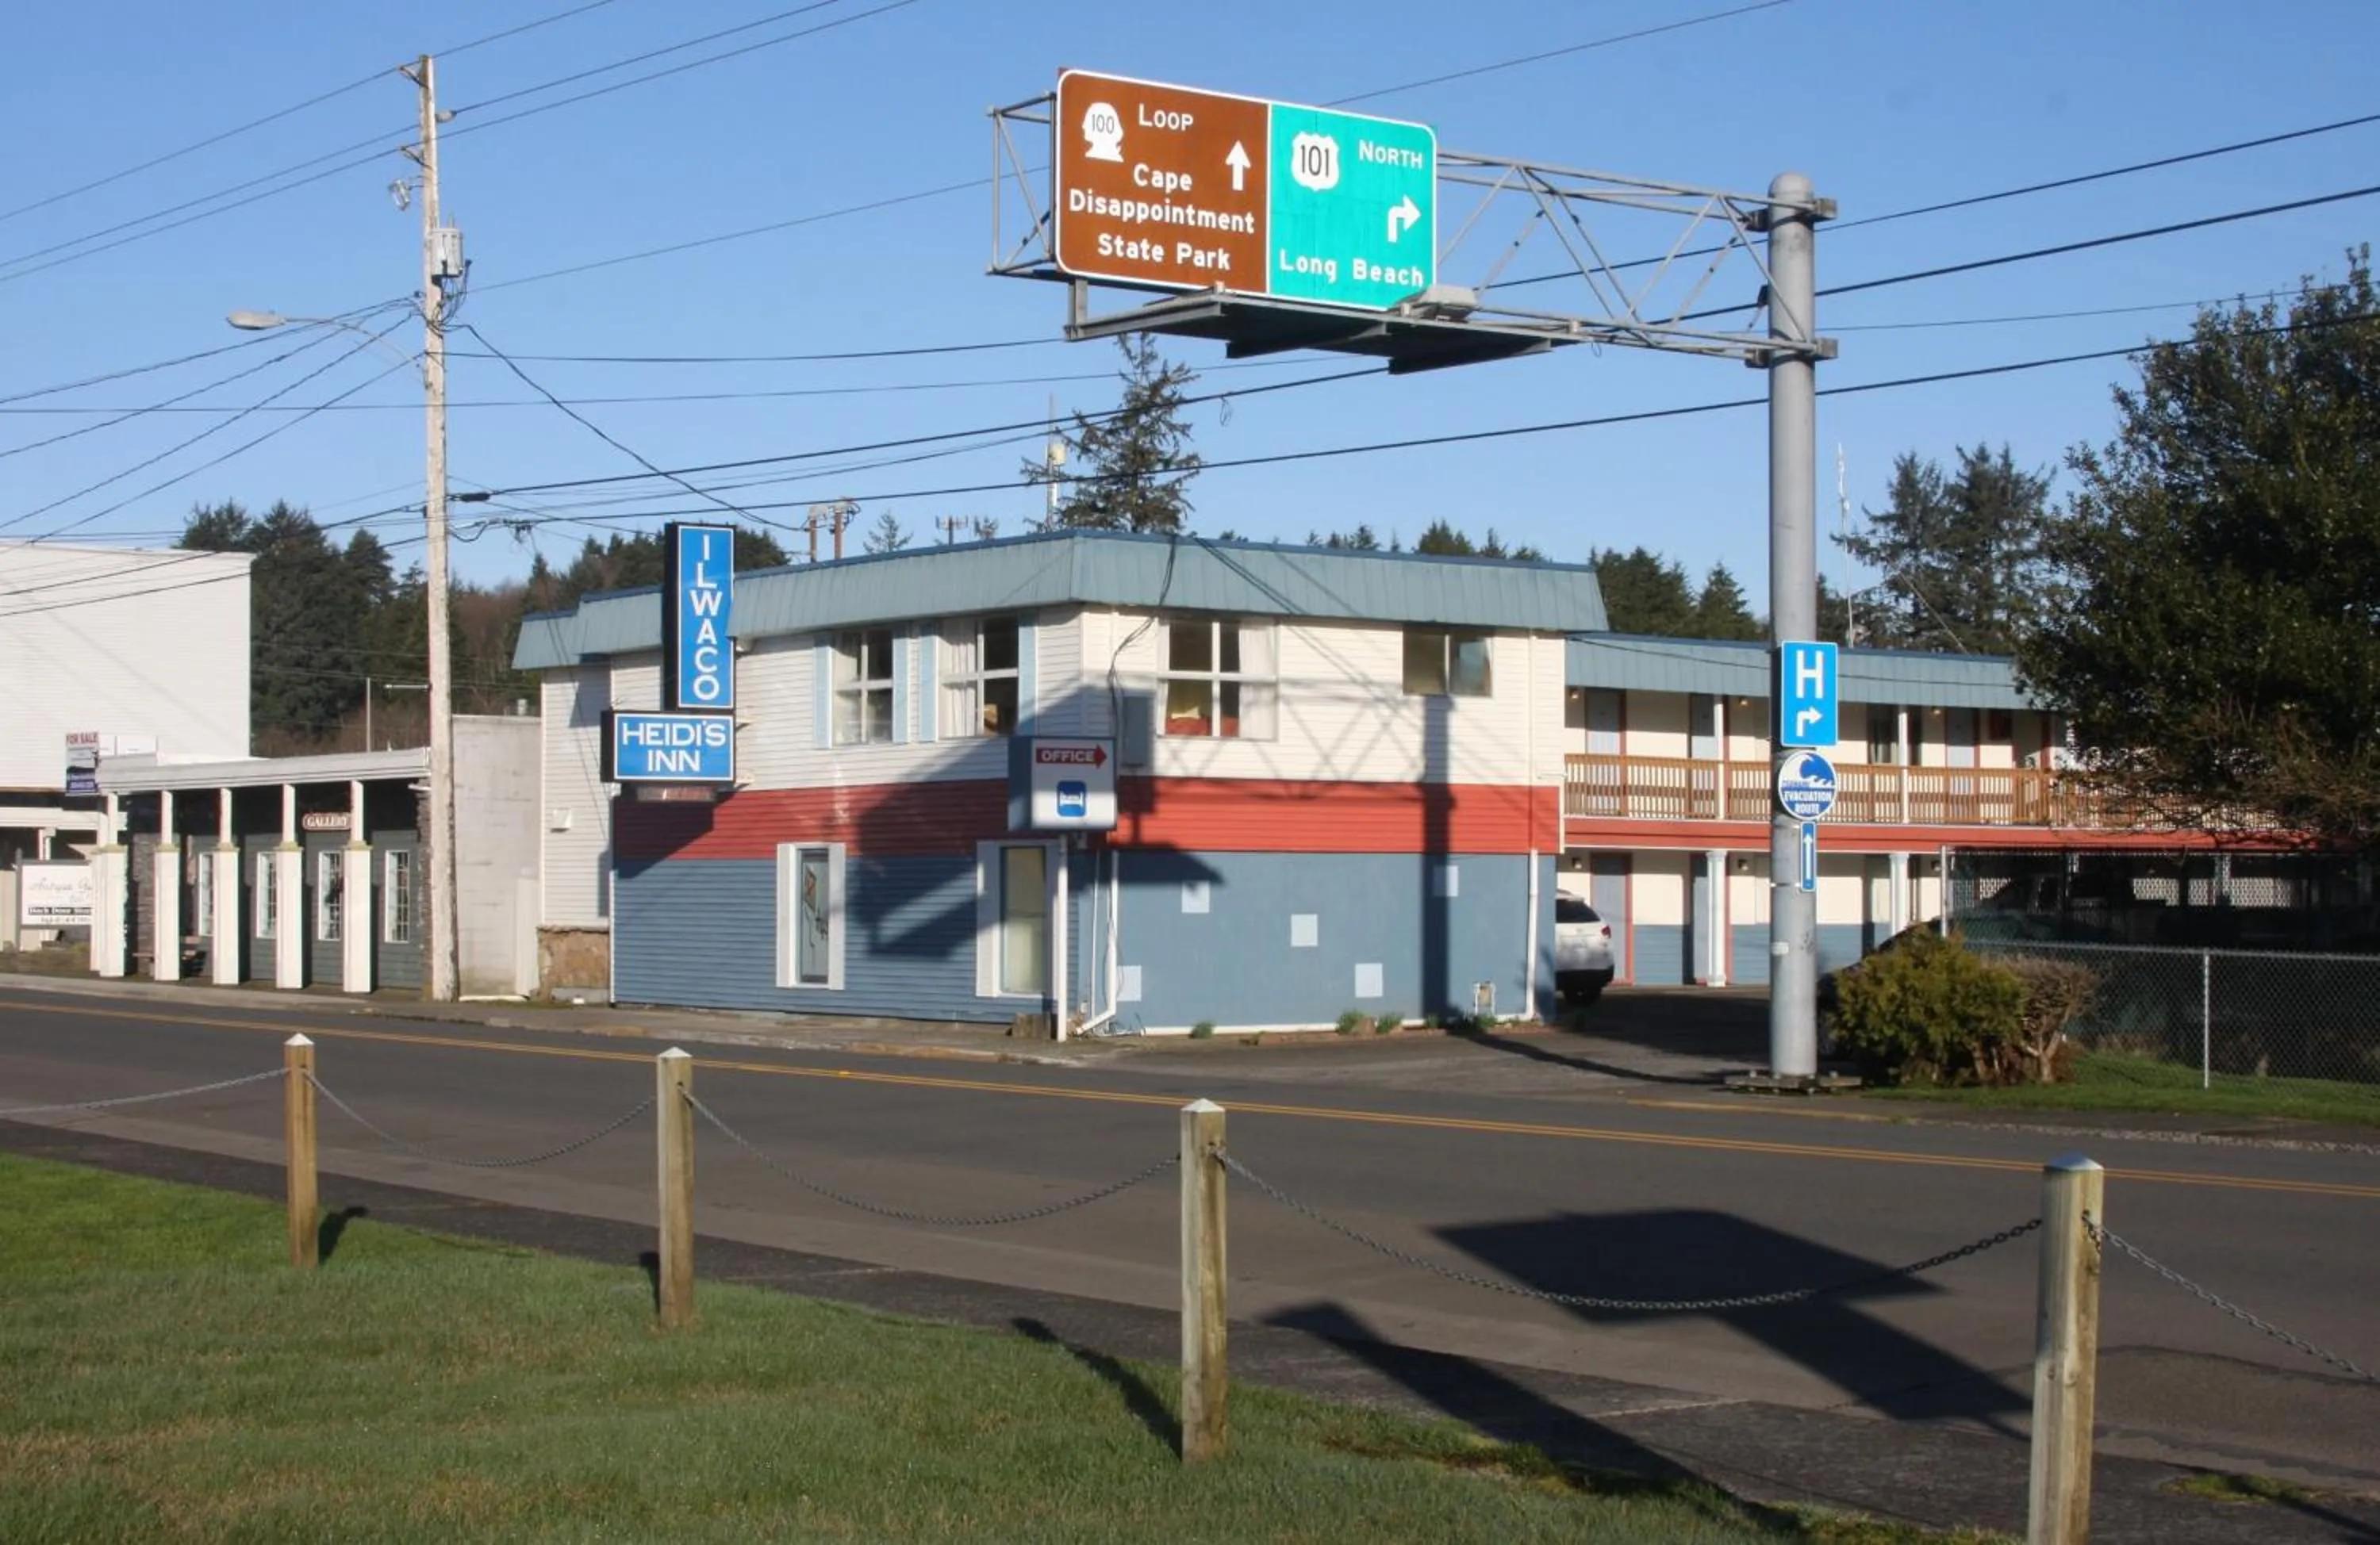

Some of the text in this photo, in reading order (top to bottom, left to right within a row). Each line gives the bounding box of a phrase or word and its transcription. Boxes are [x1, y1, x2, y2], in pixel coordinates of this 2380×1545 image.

[1091, 113, 1115, 133] 100
[1300, 144, 1330, 177] 101
[1134, 163, 1192, 194] Cape
[1069, 189, 1254, 234] Disappointment
[1098, 233, 1230, 270] State Park
[1280, 249, 1424, 288] Long Beach
[690, 534, 722, 701] ILWACO
[1796, 650, 1825, 699] H
[66, 732, 98, 744] FOR SALE
[622, 719, 727, 747] HEIDI'S
[647, 749, 701, 772] INN
[1042, 750, 1093, 762] OFFICE
[1784, 791, 1832, 802] EVACUATION
[1795, 803, 1819, 814] ROUTE
[307, 816, 347, 826] GALLERY
